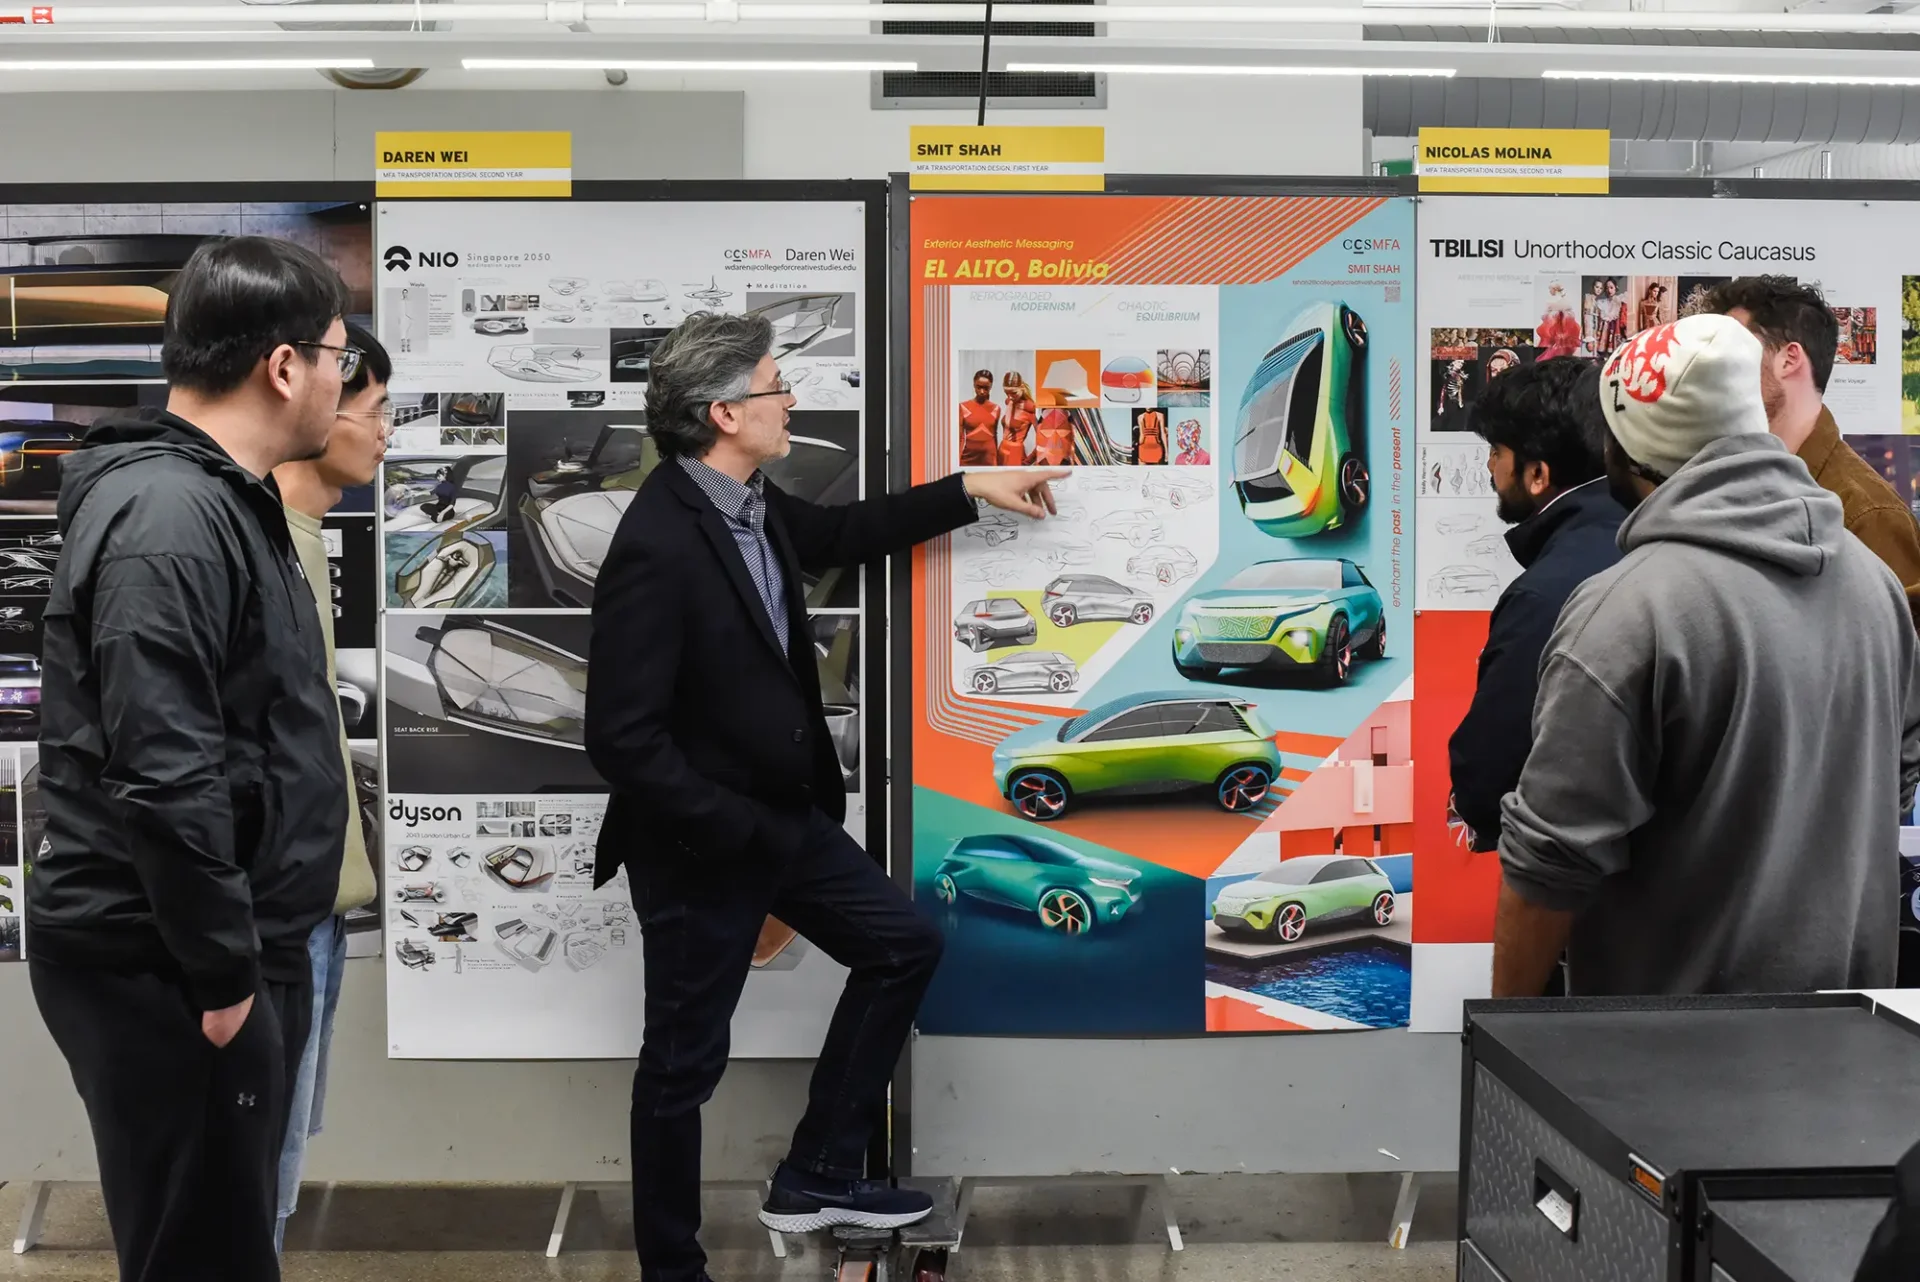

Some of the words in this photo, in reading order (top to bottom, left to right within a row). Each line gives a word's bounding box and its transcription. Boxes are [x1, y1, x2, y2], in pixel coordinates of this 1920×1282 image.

[917, 144, 954, 156] SMIT
[958, 144, 1001, 156] SHAH
[1425, 146, 1490, 158] NICOLAS
[1495, 147, 1552, 159] MOLINA
[383, 151, 435, 163] DAREN
[441, 151, 468, 162] WEI
[923, 239, 963, 249] Exterior
[964, 239, 1013, 249] Aesthetic
[1015, 239, 1075, 251] Messaging
[1343, 239, 1401, 254] CCSMFA
[1430, 239, 1504, 258] TBILISI
[1514, 240, 1636, 259] Unorthodox
[1641, 240, 1713, 260] Classic
[1718, 241, 1816, 261] Caucasus
[418, 252, 459, 268] NIO
[467, 253, 519, 262] Singapore
[524, 253, 551, 261] 2050
[724, 249, 772, 262] CCSMFA
[785, 249, 827, 261] Daren
[829, 249, 855, 261] Wei
[724, 264, 857, 272] wdaren@collegeforcreativestudies.edu
[924, 259, 948, 278] EL
[954, 259, 1020, 282] ALTO,
[1027, 259, 1110, 278] Bolivia
[1348, 264, 1371, 274] SMIT
[1373, 264, 1400, 274] SHAH
[969, 291, 1052, 301] RETROGRADED
[1010, 302, 1075, 312] MODERNISM
[1117, 301, 1169, 311] CHAOTIC
[1136, 312, 1200, 322] EQUILIBRIUM
[1392, 427, 1403, 470] present
[1391, 472, 1401, 491] the
[1391, 494, 1400, 504] in
[1391, 537, 1401, 556] the
[1391, 557, 1401, 608] enchant
[389, 799, 462, 827] dyson
